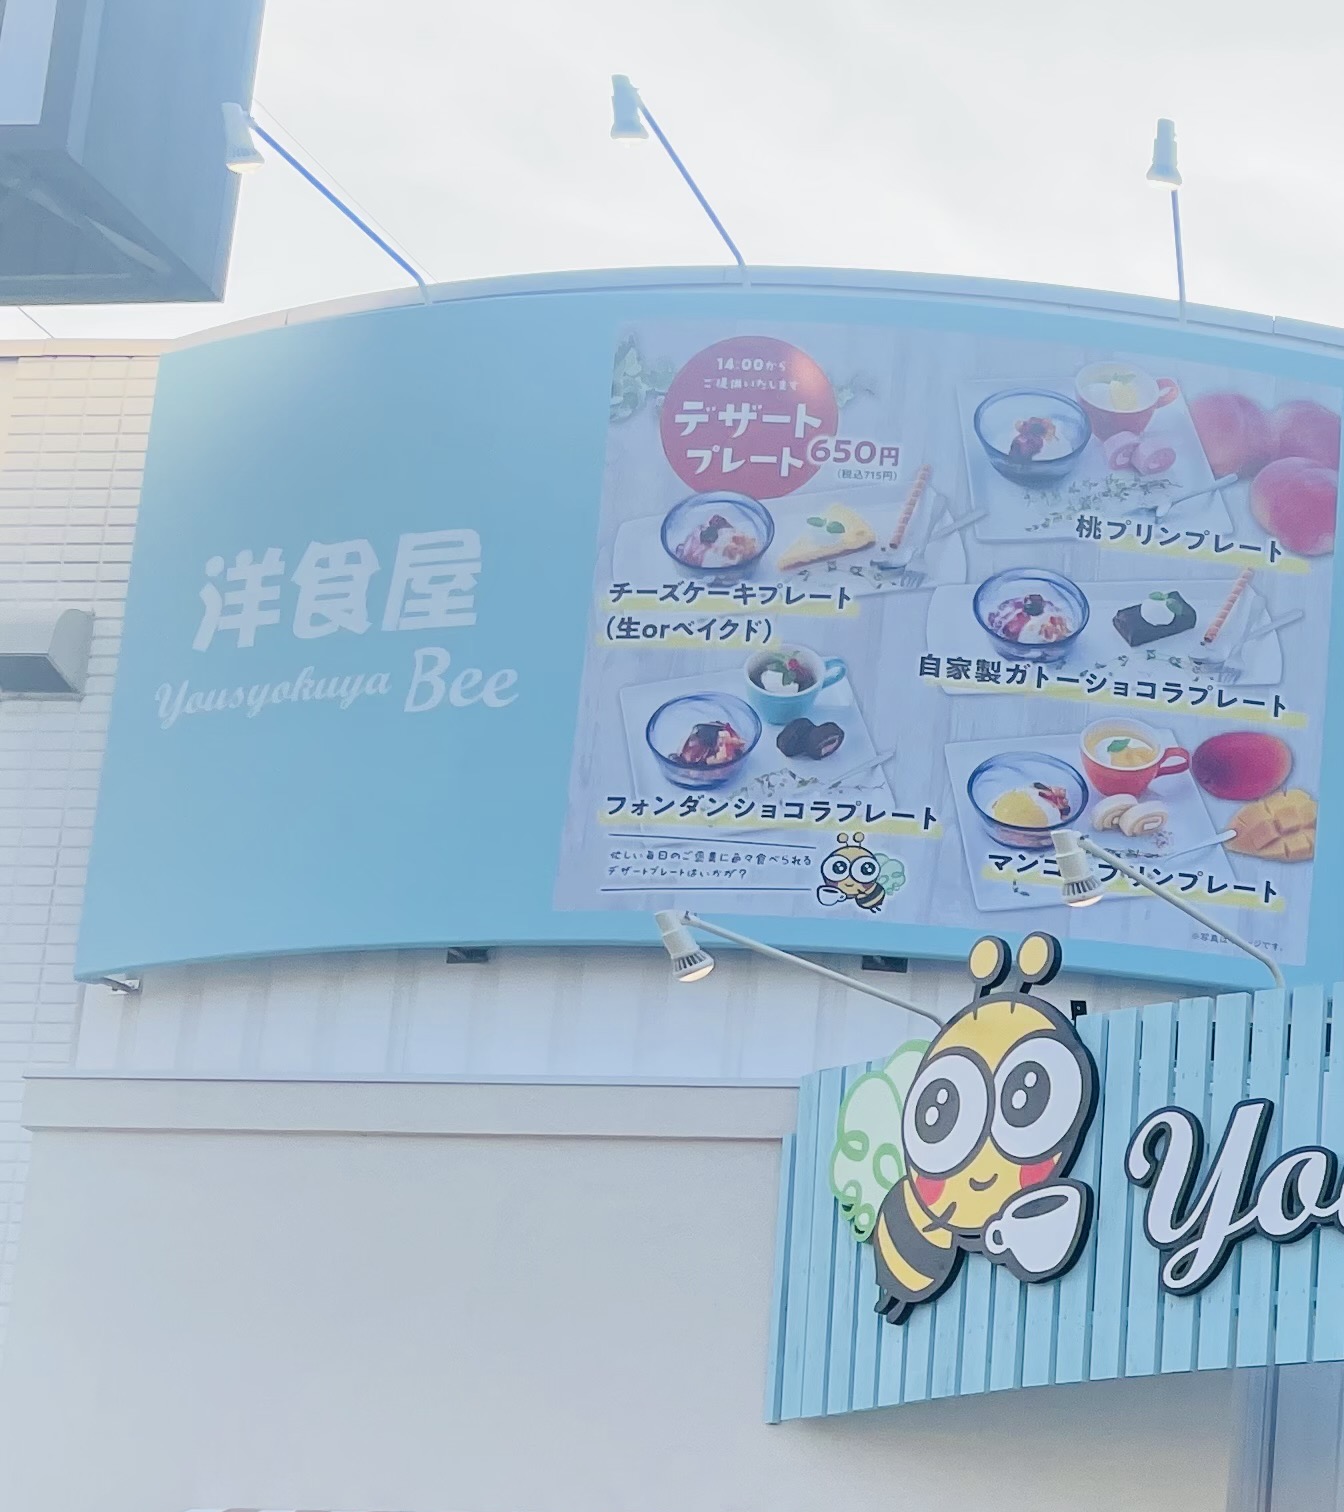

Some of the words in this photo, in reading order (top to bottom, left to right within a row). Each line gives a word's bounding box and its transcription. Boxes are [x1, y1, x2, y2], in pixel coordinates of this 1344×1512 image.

[675, 401, 822, 438] デザート
[686, 445, 803, 477] プレート
[810, 439, 900, 467] 650円
[1076, 515, 1283, 563] 桃プリンプレート
[192, 528, 483, 652] 洋食屋
[609, 581, 852, 610] チーズケーキプレート
[606, 615, 773, 643] (生orベイクド)
[155, 665, 392, 730] Yousyokuya
[403, 646, 519, 713] Bee
[918, 653, 1288, 718] 自家製ガトーショコラプレート
[607, 794, 938, 831] フォンダンショコラプレート
